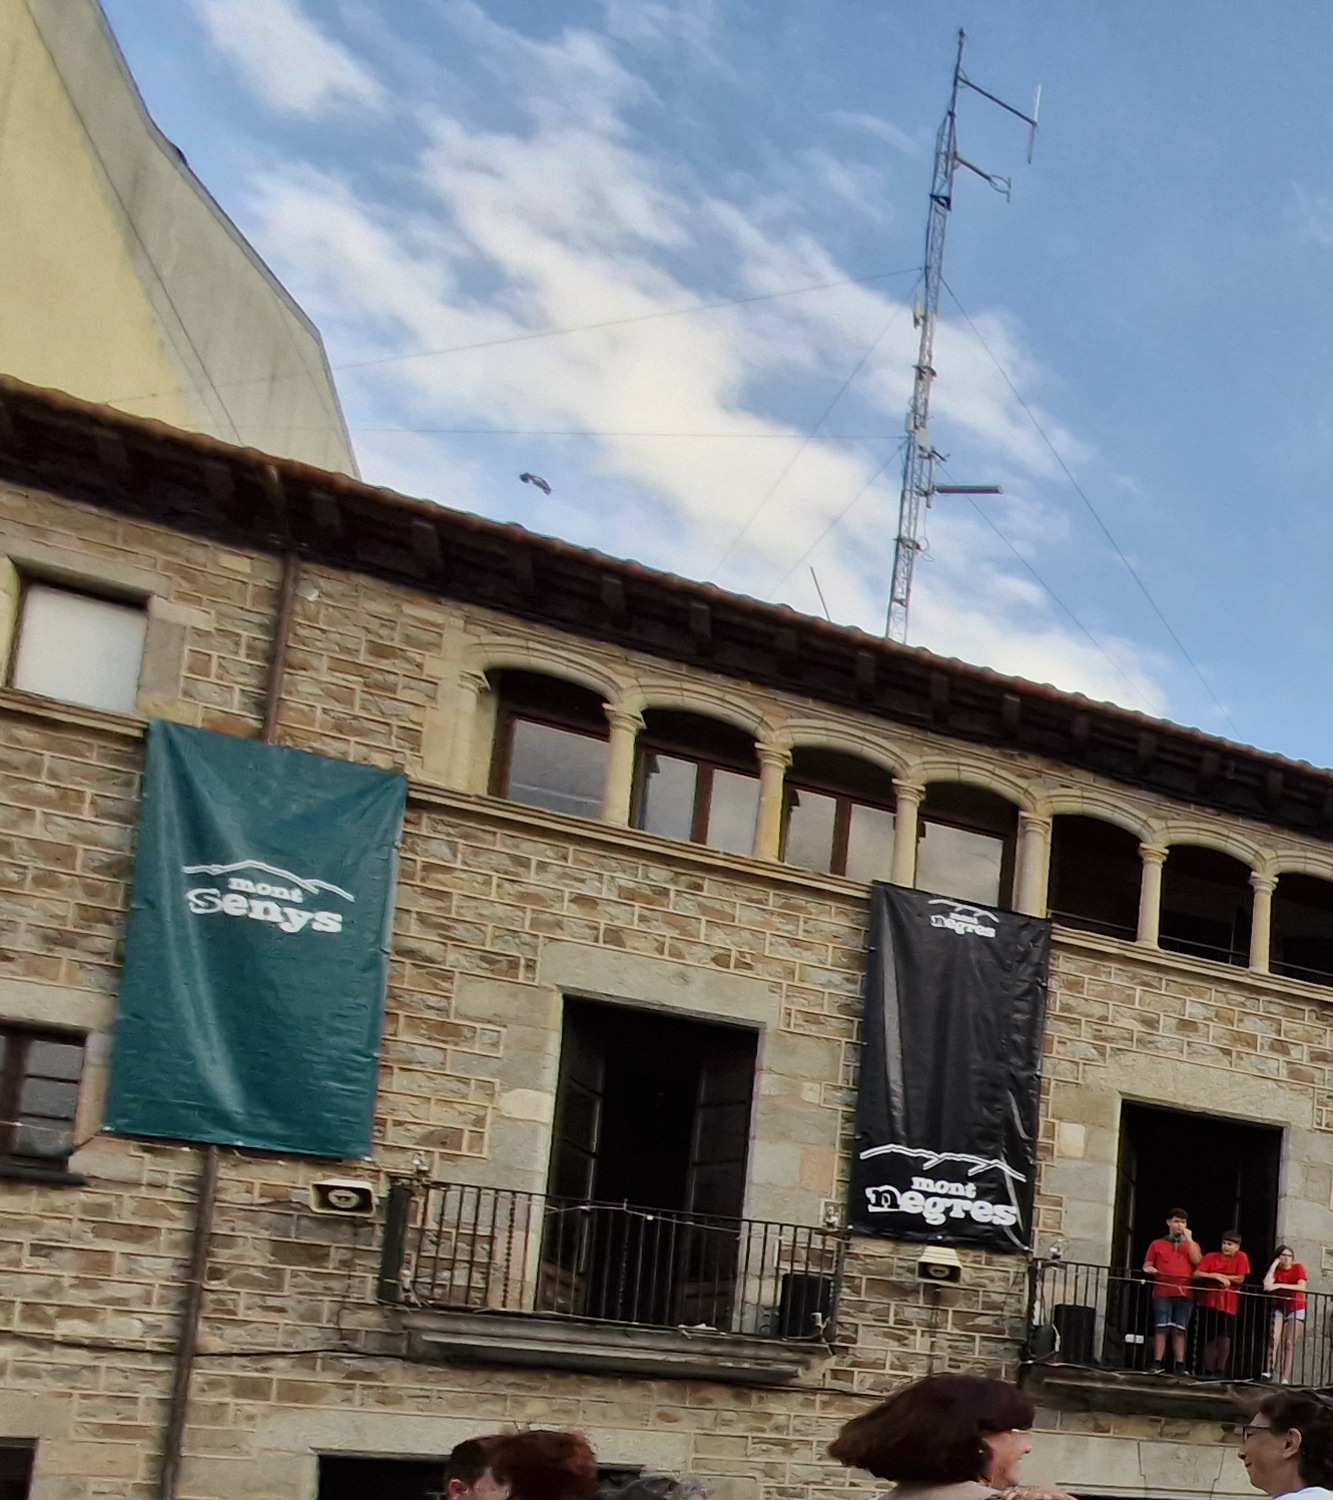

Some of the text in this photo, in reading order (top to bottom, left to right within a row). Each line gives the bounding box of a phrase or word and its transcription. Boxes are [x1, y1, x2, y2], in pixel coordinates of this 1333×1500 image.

[228, 877, 303, 903] mont
[911, 1176, 977, 1198] mont
[865, 1185, 1017, 1225] negres
